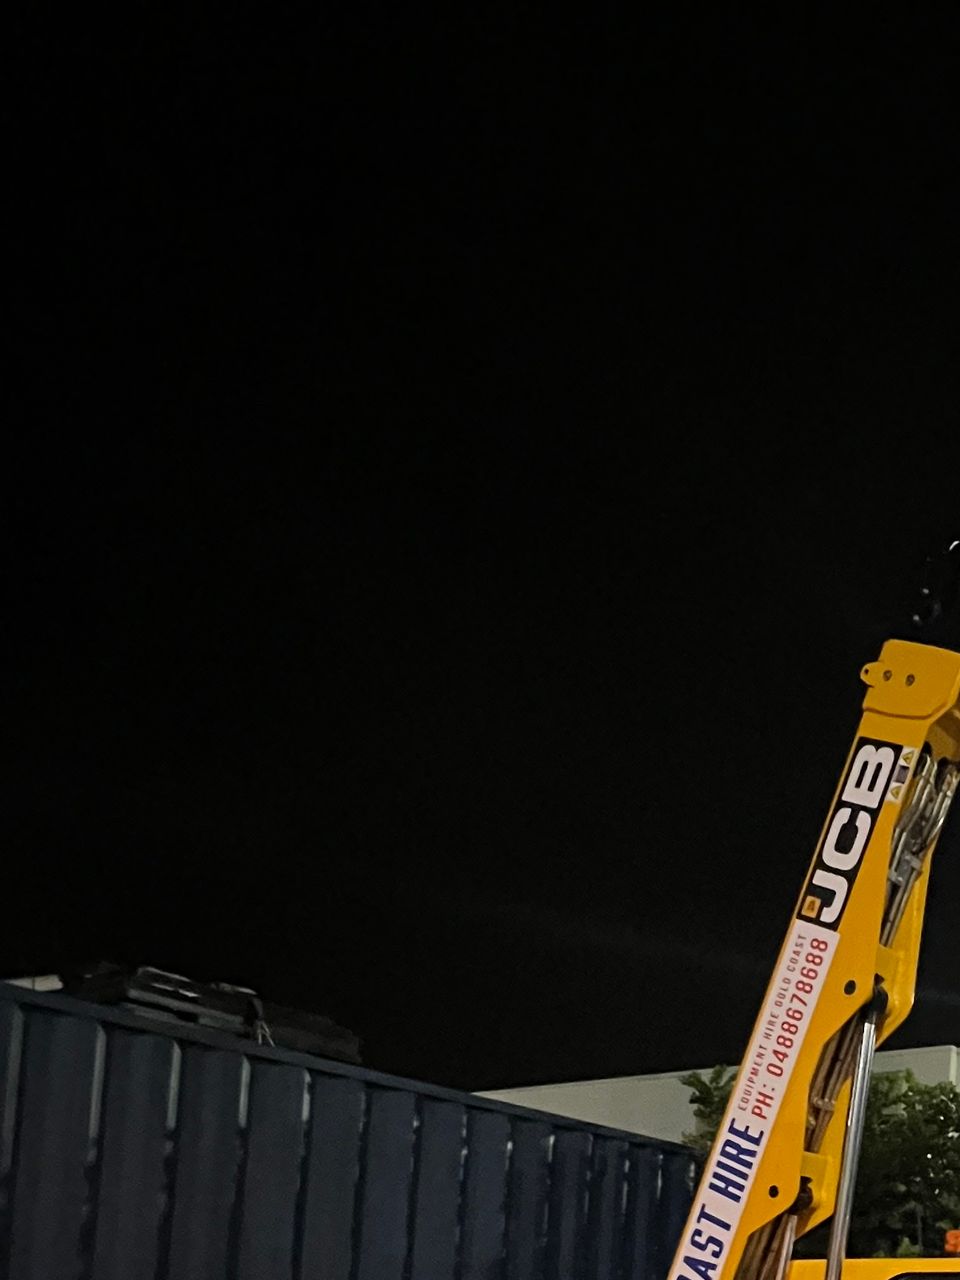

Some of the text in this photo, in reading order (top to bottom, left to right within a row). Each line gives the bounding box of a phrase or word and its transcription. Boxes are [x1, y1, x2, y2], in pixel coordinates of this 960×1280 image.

[811, 743, 895, 925] JCB
[738, 1045, 768, 1112] EQUIPMENT
[764, 1012, 780, 1041] HIRE
[787, 934, 807, 972] COAST
[751, 937, 829, 1121] PH: 0488678688
[709, 1117, 763, 1204] HIRE
